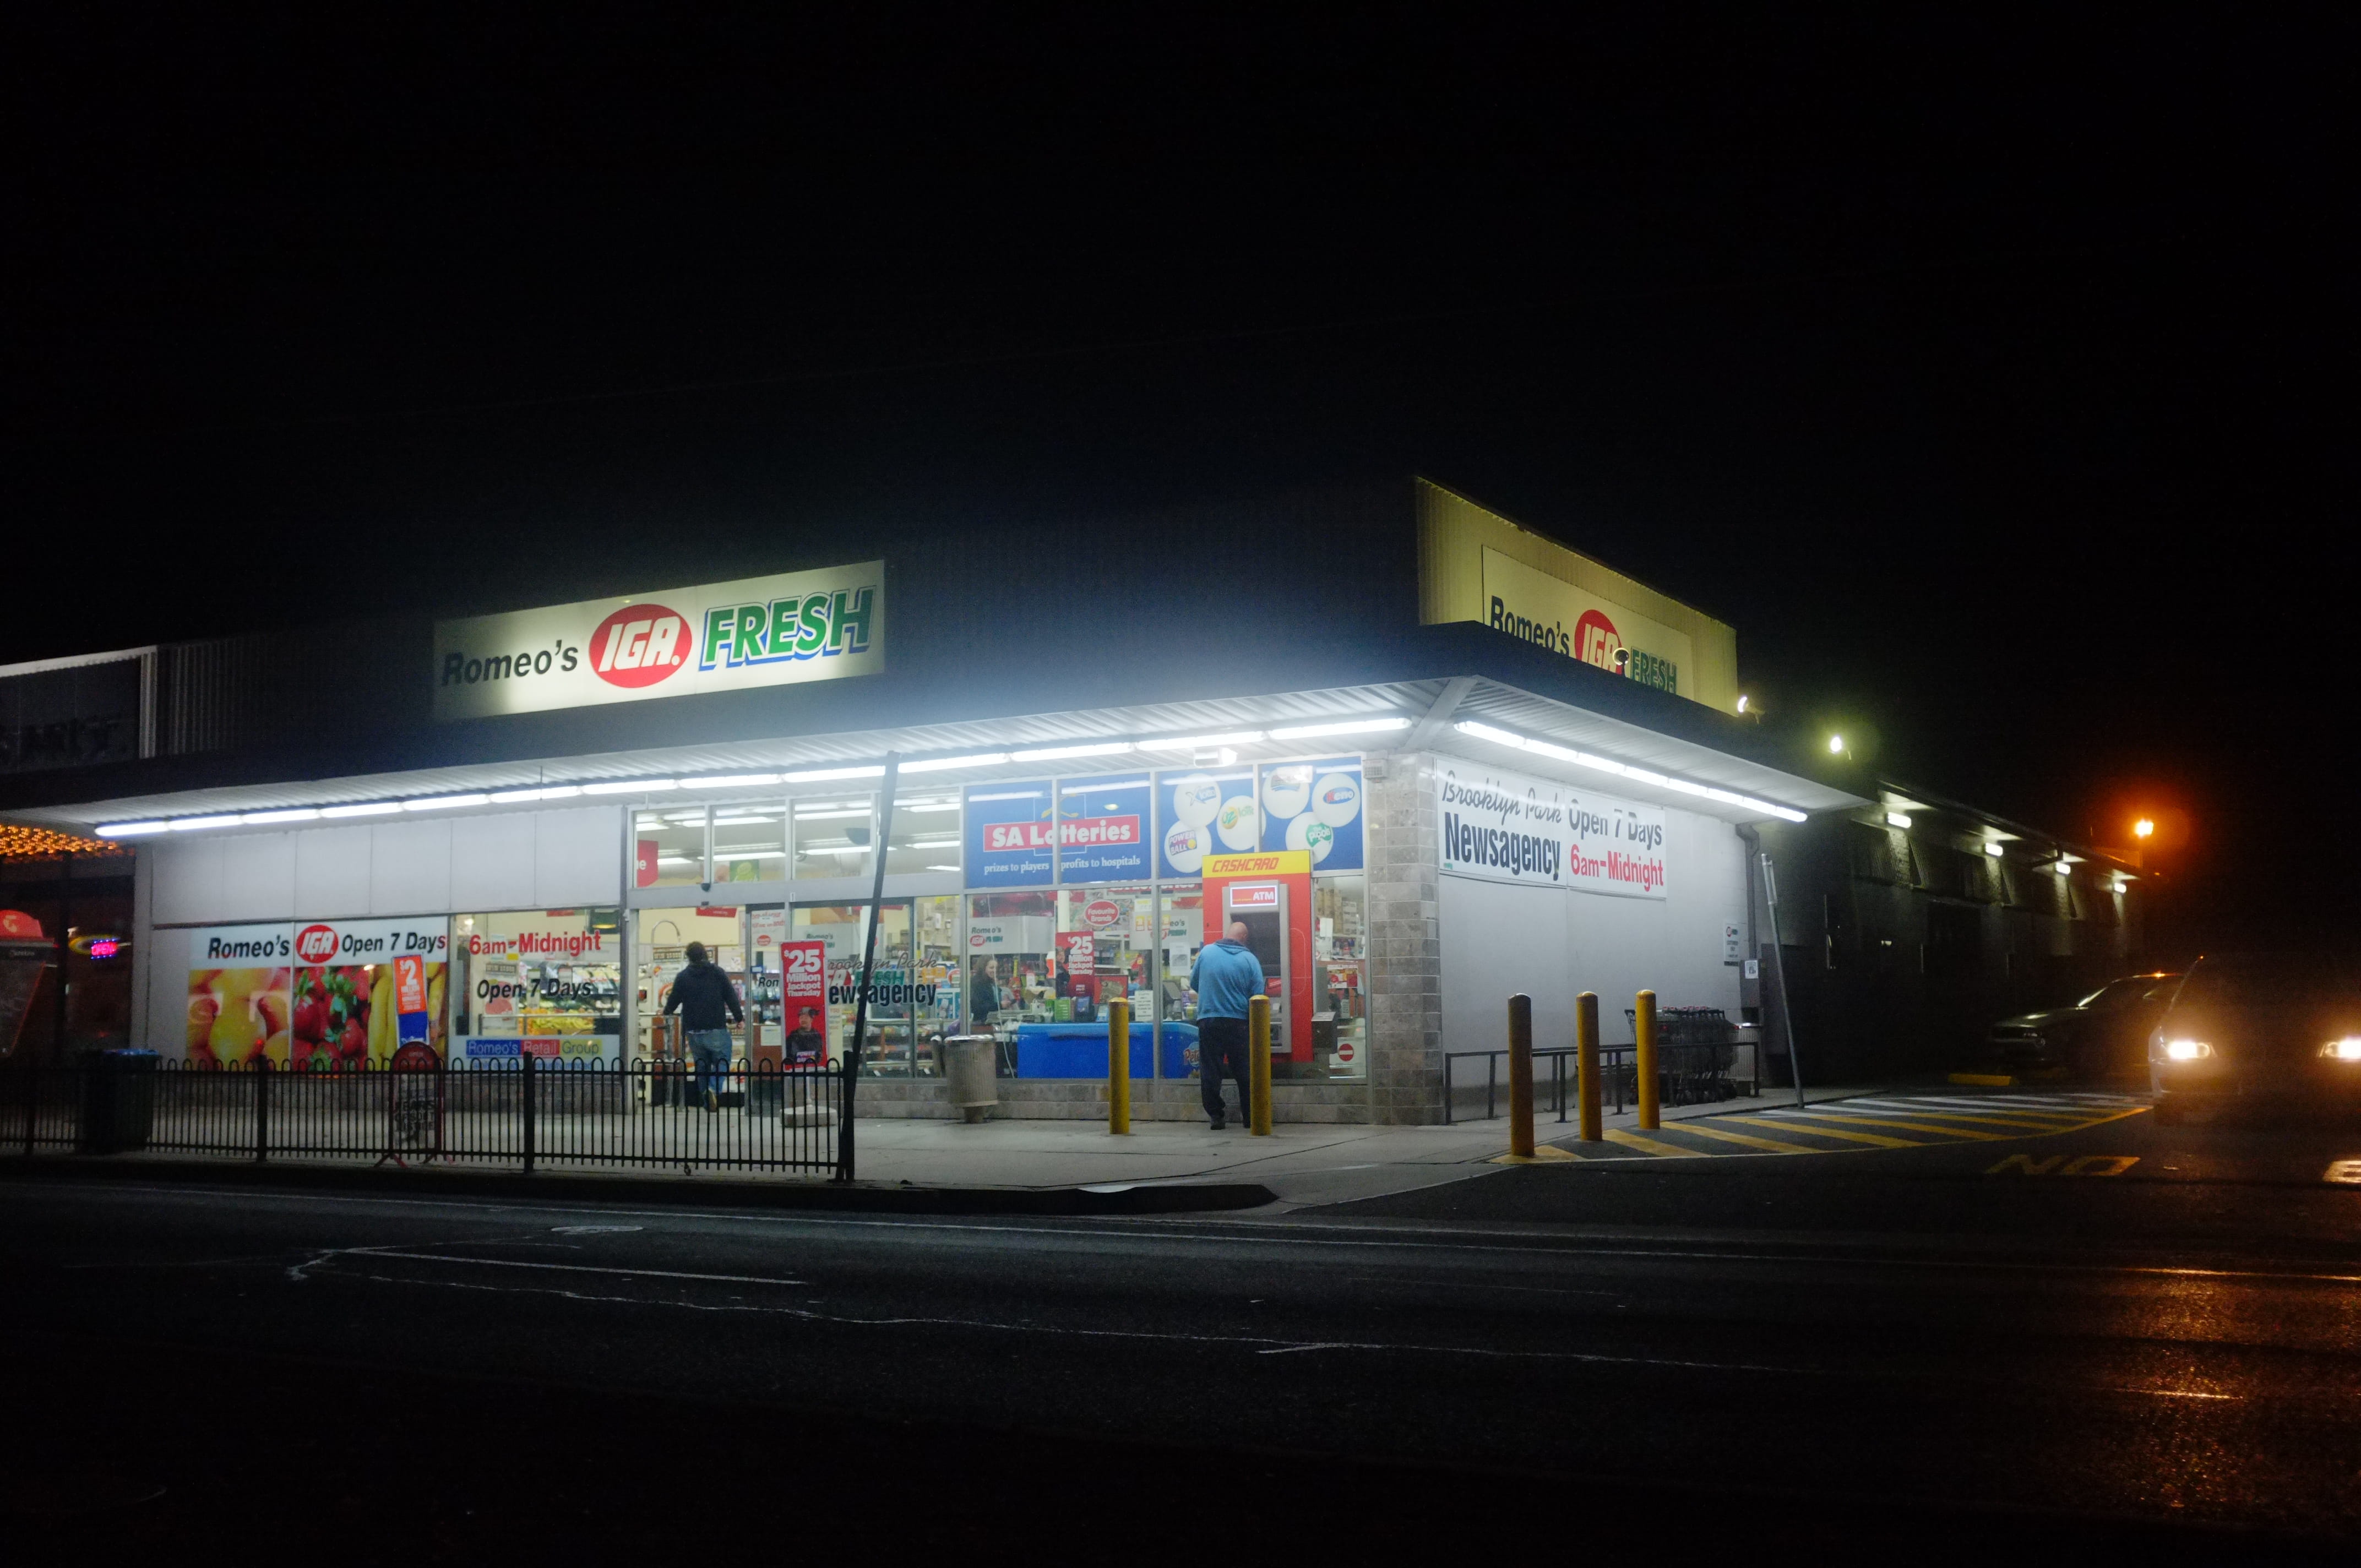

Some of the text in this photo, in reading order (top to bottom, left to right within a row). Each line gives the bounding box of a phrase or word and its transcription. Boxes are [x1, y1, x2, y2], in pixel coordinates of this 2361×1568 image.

[441, 640, 578, 686] Romeo's
[698, 585, 877, 672] FRESH
[1490, 595, 1677, 694] Romeo's IGA FRESH
[1326, 790, 1354, 803] Keno
[1442, 770, 1562, 825] Brooklyn Park
[992, 820, 1131, 848] SA Lotteries
[1569, 798, 1662, 851] Open 7 Days
[1168, 830, 1196, 844] POWER
[1444, 812, 1560, 881] Newsagency
[1171, 845, 1188, 857] BALL
[984, 855, 1141, 875] prizes to players profits to hospitals
[1212, 857, 1279, 873] CASHCARD
[1570, 843, 1664, 892] 6am-Midnight
[1253, 891, 1275, 901] ATM
[971, 926, 1002, 934] Romeo's
[208, 930, 447, 959] Romeo's IGA Open 7 Days
[469, 929, 601, 957] 6am-Midnight
[1068, 935, 1093, 955] $25
[784, 949, 821, 973] $25
[787, 973, 821, 982] Million
[787, 981, 821, 991] Jackpot
[477, 978, 592, 1004] Open 7 Days
[787, 989, 821, 998] Thursday
[829, 984, 936, 1006] ewagency
[469, 1039, 599, 1056] Romeo's Retail Group
[1984, 1155, 2140, 1176] NO
